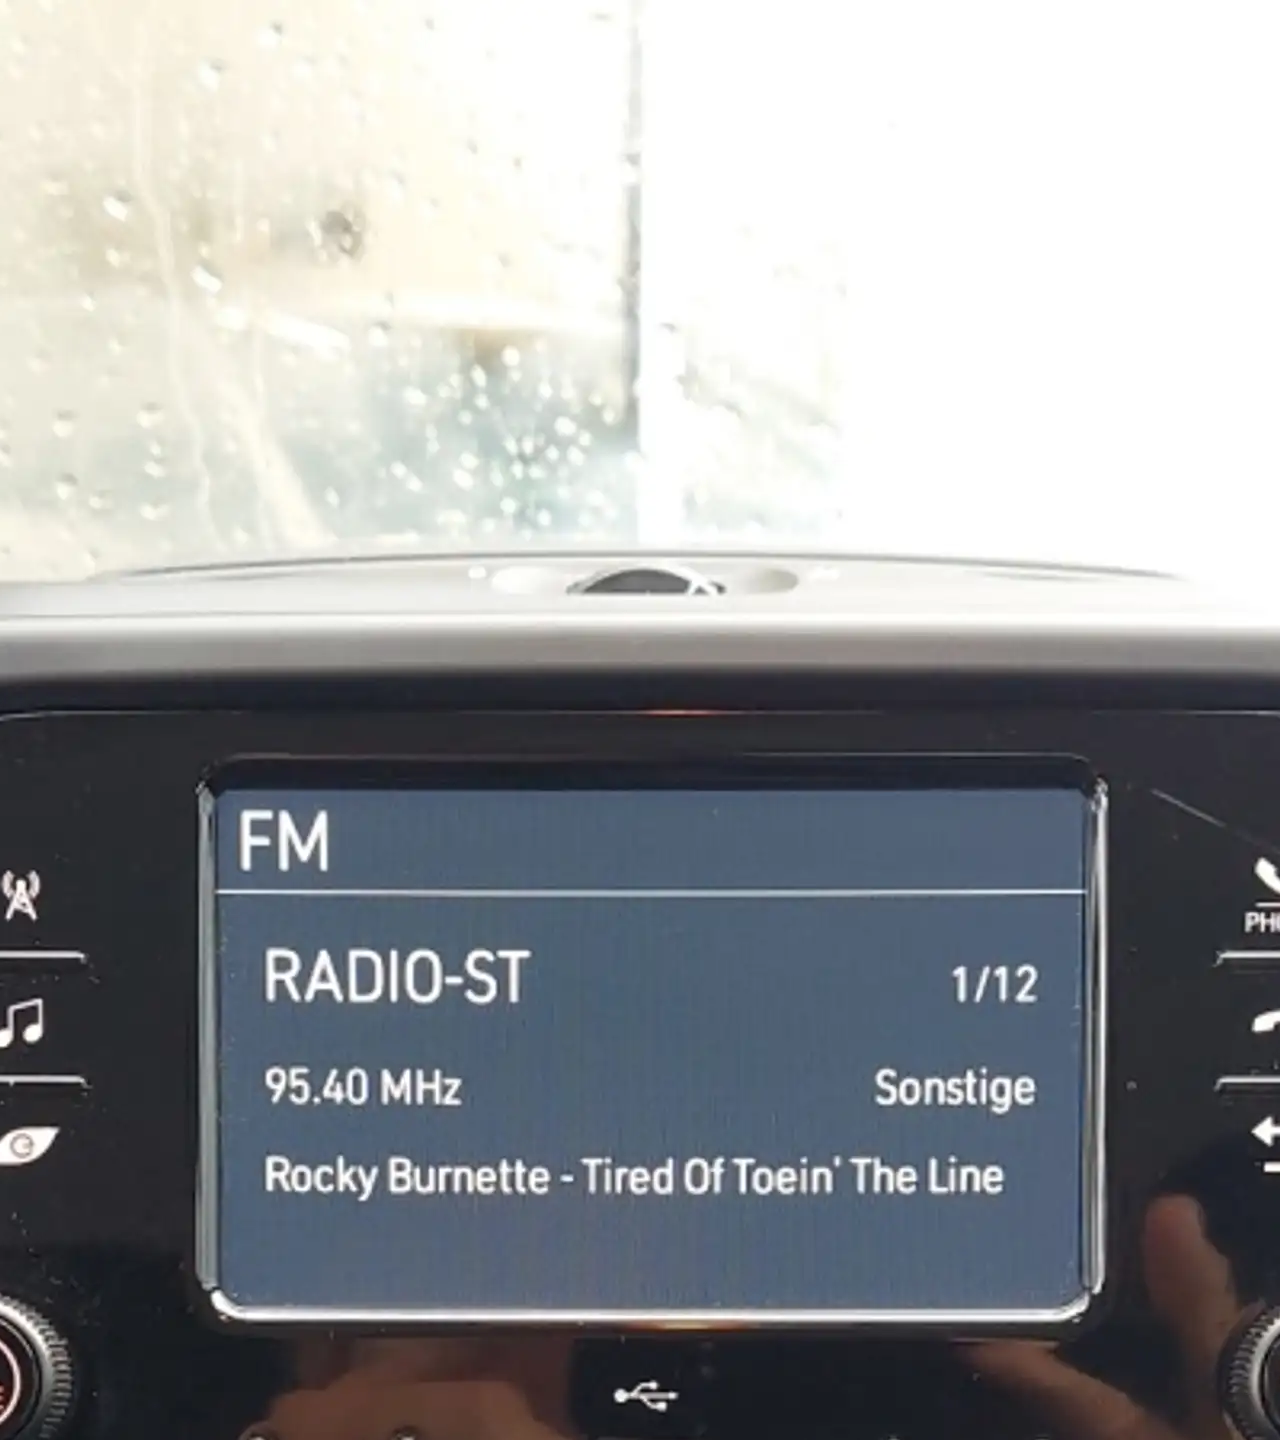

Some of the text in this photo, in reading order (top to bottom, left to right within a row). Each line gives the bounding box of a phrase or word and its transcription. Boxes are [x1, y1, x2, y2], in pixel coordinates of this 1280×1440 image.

[239, 808, 329, 872] FM
[265, 947, 531, 1004] RADIO-ST
[951, 964, 1038, 1003] 1/12
[265, 1067, 462, 1106] 95.40 MHz
[875, 1067, 1037, 1114] Sonstige
[265, 1155, 378, 1202] Rocky
[388, 1156, 550, 1195] Burnette
[580, 1156, 675, 1195] Tired
[684, 1156, 726, 1195] Of
[731, 1155, 841, 1195] Toein'
[850, 1156, 918, 1195] The
[928, 1156, 1004, 1195] Line
